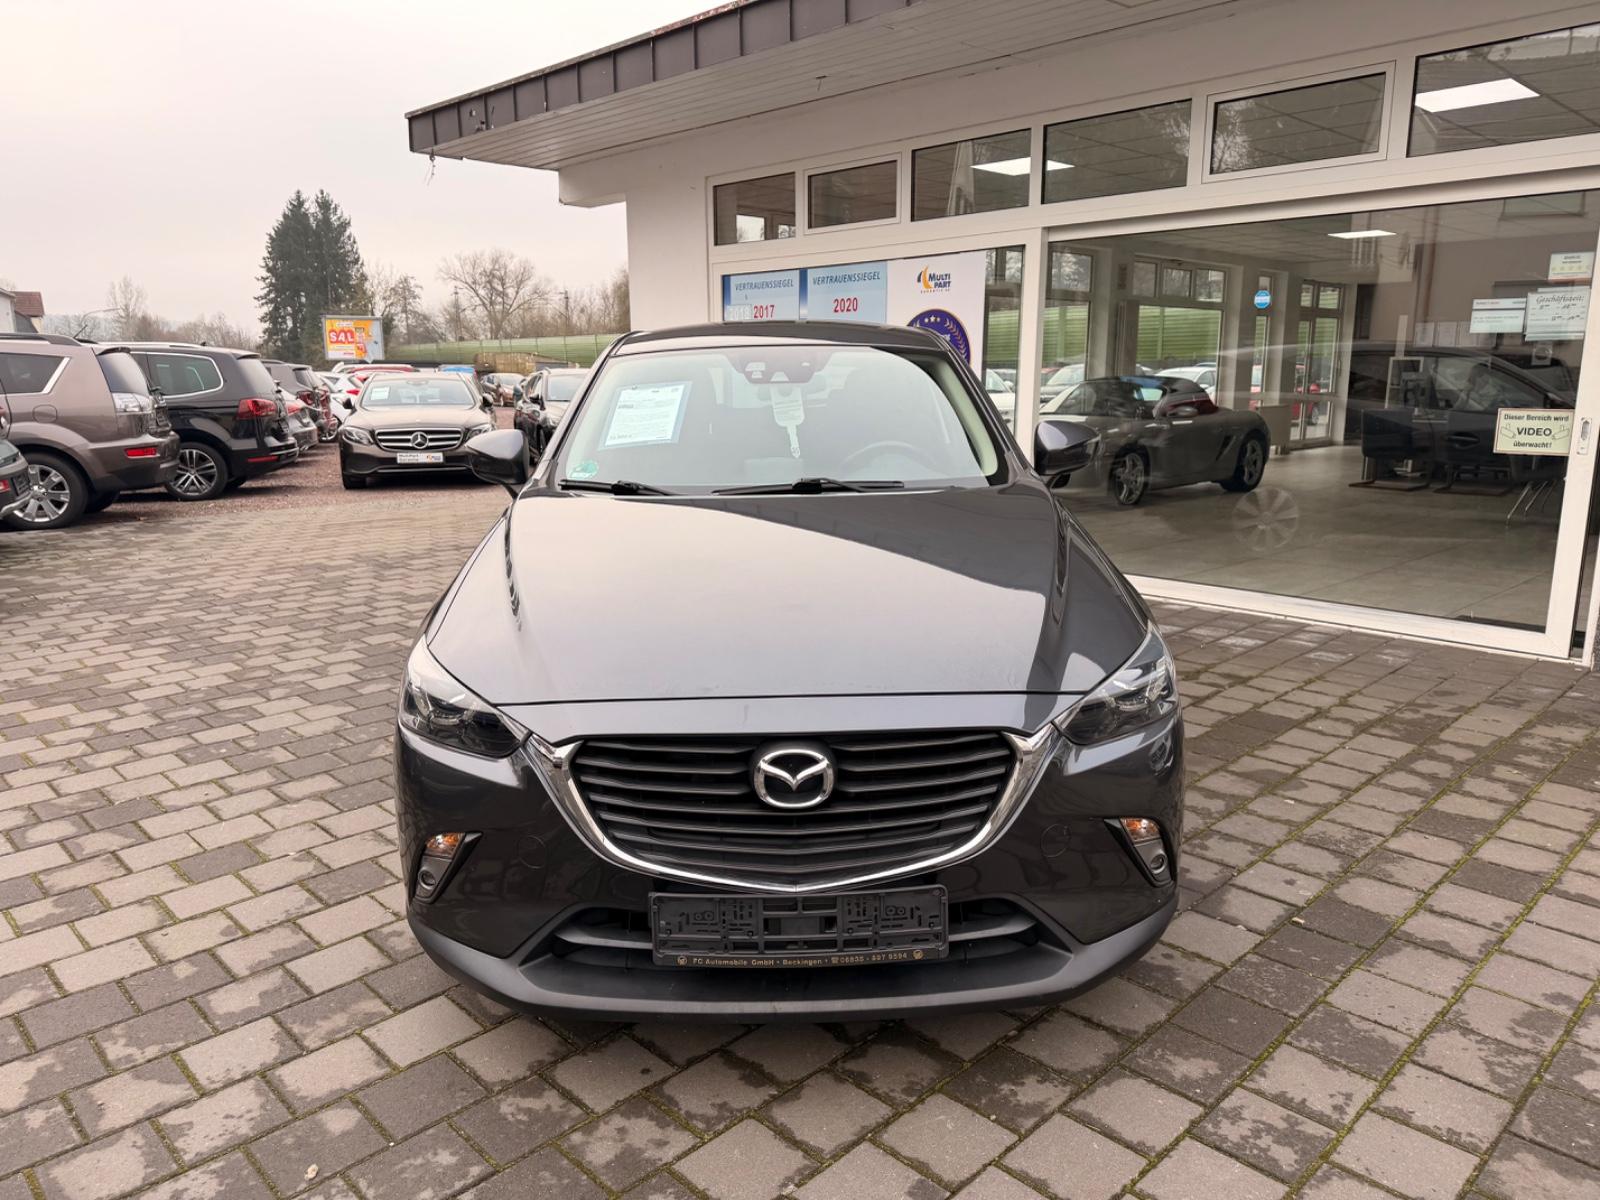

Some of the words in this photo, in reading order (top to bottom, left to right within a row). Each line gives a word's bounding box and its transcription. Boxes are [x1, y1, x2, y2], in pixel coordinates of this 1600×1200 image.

[812, 271, 881, 286] VERTRAUENSSIEGEL
[735, 278, 794, 291] VERTRAUENSSIEGEL
[934, 281, 951, 289] PART
[833, 297, 858, 313] 2020
[753, 304, 775, 319] 2017
[1504, 413, 1525, 421] Dieser
[1553, 414, 1569, 422] wird
[1516, 427, 1552, 437] VIDEO
[1513, 440, 1552, 449] überwacht!
[705, 958, 748, 966] Automobile
